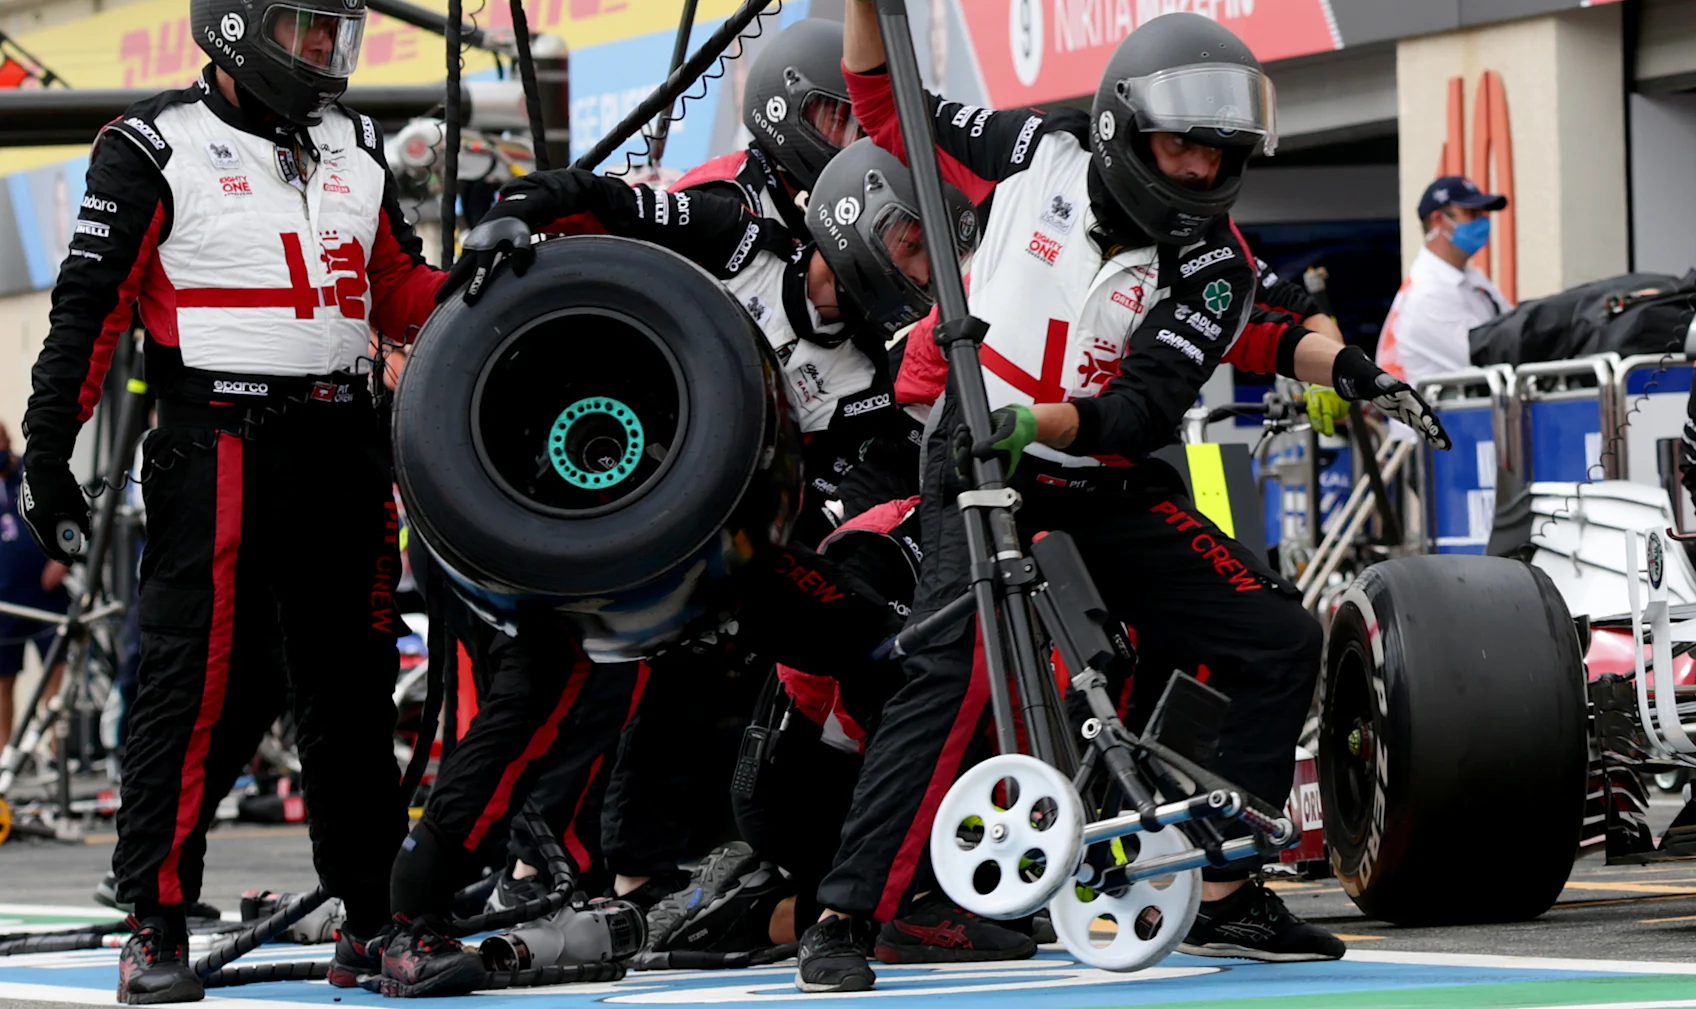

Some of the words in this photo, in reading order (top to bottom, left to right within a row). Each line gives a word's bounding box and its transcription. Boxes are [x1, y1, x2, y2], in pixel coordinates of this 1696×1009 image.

[204, 25, 245, 67] IQONIQ
[124, 116, 166, 150] sparco
[752, 108, 785, 146] IQONIQ
[1010, 115, 1043, 164] sparco
[222, 182, 250, 193] ONE
[817, 203, 848, 250] IQONIQ
[1033, 231, 1063, 250] EIGHTY
[725, 223, 760, 272] sparco
[1029, 239, 1060, 264] ONE
[1180, 247, 1235, 278] sparco
[1191, 311, 1222, 336] ADLER
[213, 380, 268, 396] sparco
[844, 393, 891, 417] sparco
[1069, 480, 1087, 489] PIT
[384, 502, 398, 548] PIT
[1151, 501, 1201, 531] PIT
[1191, 533, 1262, 592] CREW
[371, 556, 393, 634] CREW
